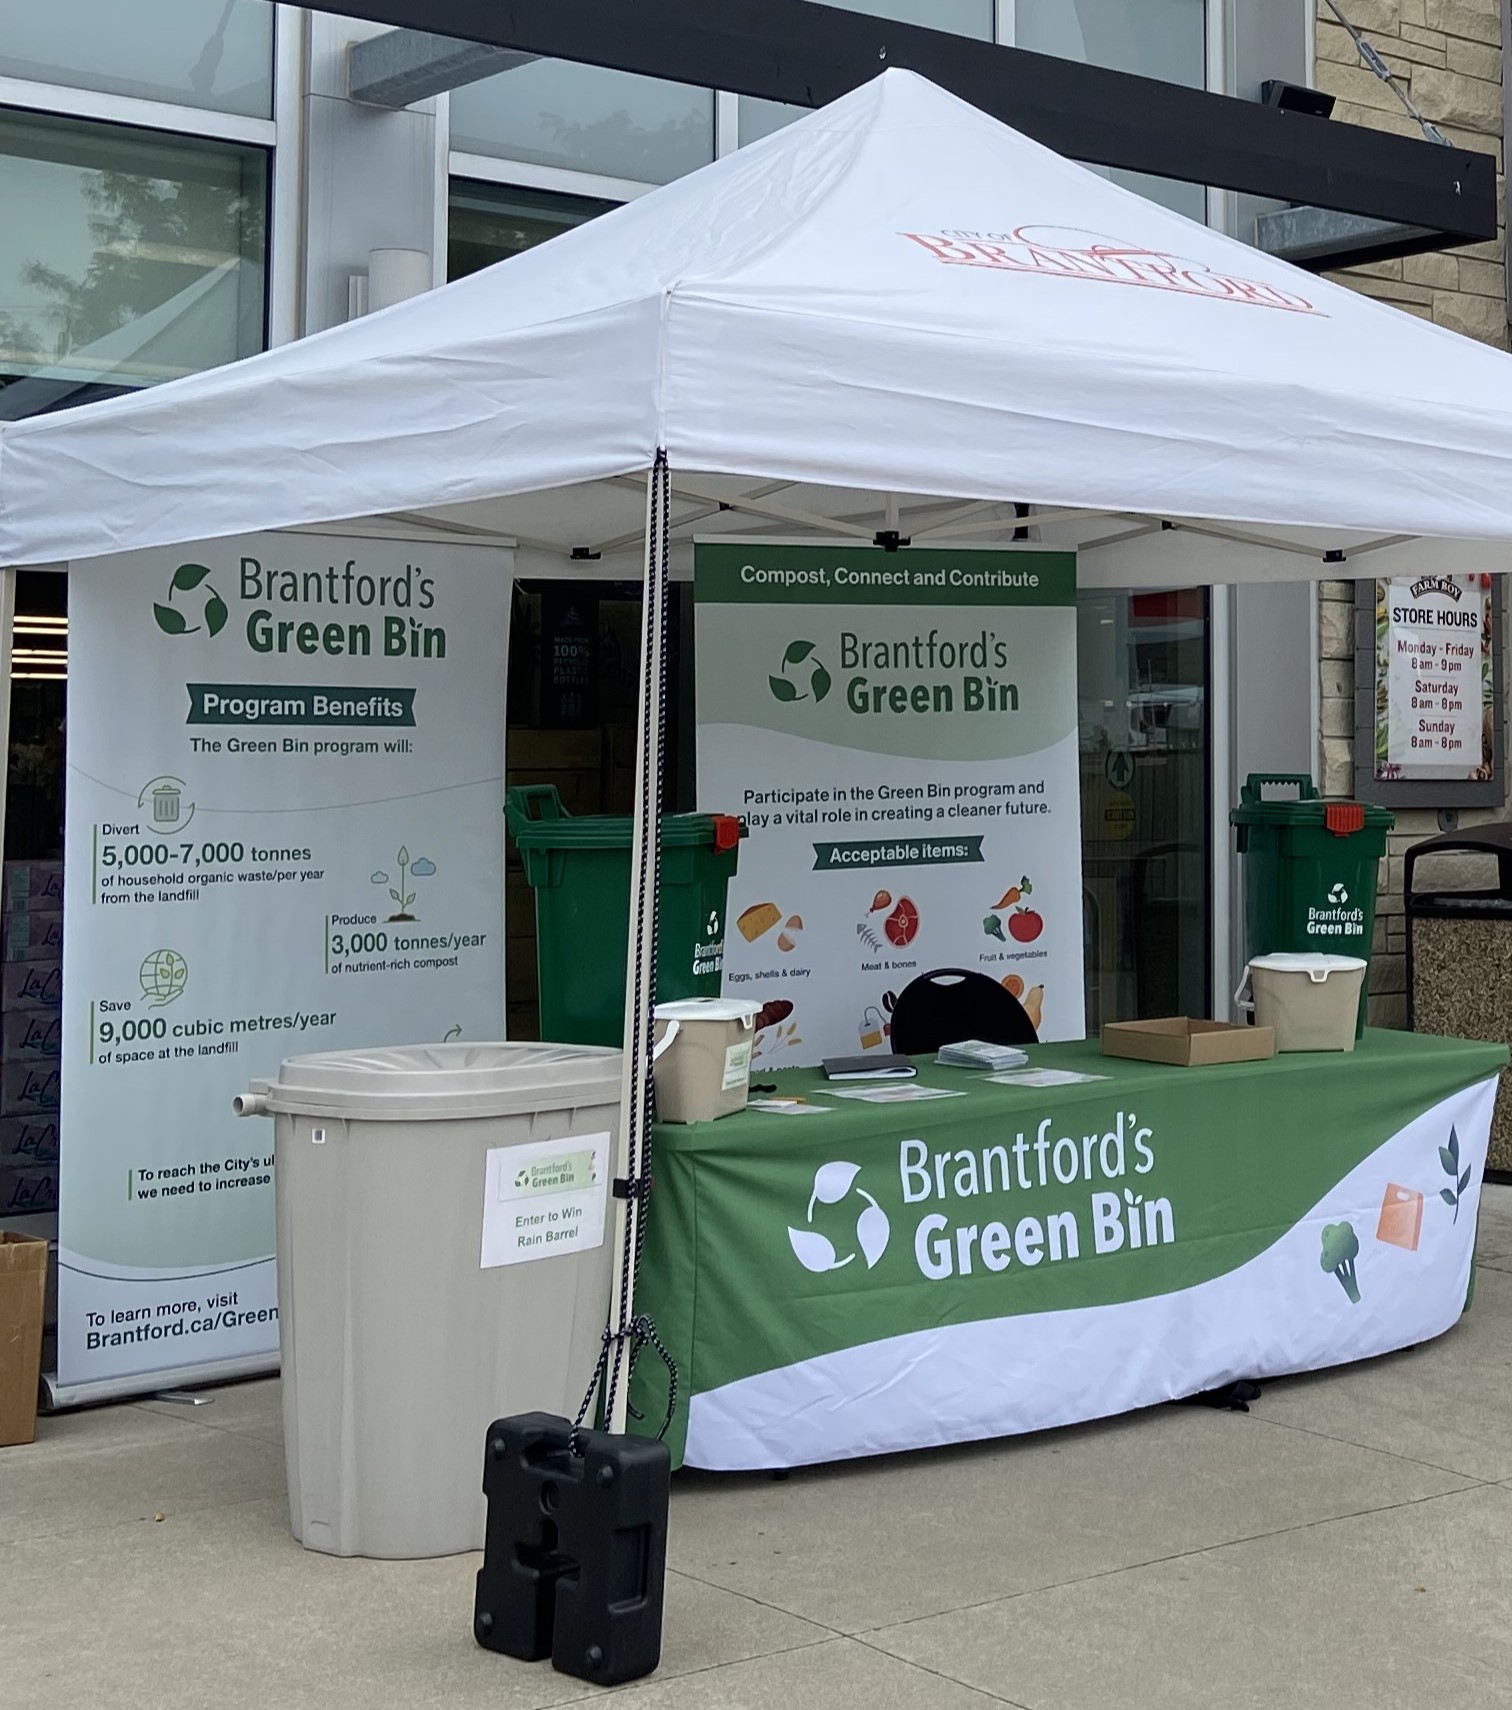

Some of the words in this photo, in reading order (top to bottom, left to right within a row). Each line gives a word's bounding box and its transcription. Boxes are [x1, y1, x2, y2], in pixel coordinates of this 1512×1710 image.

[941, 228, 982, 240] CITY
[988, 232, 1015, 242] OF
[897, 232, 1313, 310] BRANTFORD
[240, 557, 435, 609] Brantford's
[740, 565, 831, 588] Compost,
[834, 566, 910, 586] Connect
[913, 569, 946, 586] and
[949, 569, 1039, 587] Contribute
[1411, 579, 1439, 595] FARM
[1441, 579, 1461, 598] BOY
[1393, 607, 1433, 624] STORE
[1437, 610, 1477, 627] HOURS
[247, 609, 370, 656] Green
[384, 615, 446, 658] Bin
[553, 645, 590, 657] 100%
[841, 629, 1007, 669] Brantford's
[1397, 640, 1437, 657] Monday
[1445, 643, 1474, 658] Friday
[847, 676, 953, 714] Green
[963, 675, 1019, 712] Bin
[1415, 680, 1458, 697] Saturday
[203, 693, 305, 720] Program
[313, 695, 403, 717] Benefits
[1419, 719, 1455, 735] Sunday
[190, 737, 221, 752] The
[227, 737, 277, 753] Green
[282, 738, 309, 753] Bin
[314, 739, 378, 755] program
[384, 739, 413, 753] will:
[744, 788, 830, 806] Participate
[833, 786, 847, 801] in
[851, 786, 875, 801] the
[878, 785, 924, 800] Green
[927, 783, 951, 798] Bin
[954, 782, 1015, 799] program
[1018, 780, 1045, 795] and
[773, 813, 782, 824] a
[786, 809, 818, 824] vital
[822, 808, 851, 823] role
[855, 807, 868, 822] in
[871, 805, 933, 822] creating
[936, 808, 945, 819] a
[948, 803, 1001, 818] cleaner
[1005, 800, 1051, 815] future.
[102, 823, 139, 836] Divert
[102, 842, 244, 870] 5,000-7,000
[251, 846, 311, 862] tonnes
[830, 844, 919, 864] Acceptable
[922, 842, 968, 858] items:
[101, 873, 115, 887] of
[118, 871, 184, 887] household
[188, 870, 234, 886] organic
[238, 868, 296, 883] waste/per
[300, 868, 325, 882] year
[101, 891, 130, 904] from
[134, 890, 154, 903] the
[158, 888, 200, 902] landfill
[332, 914, 377, 925] Produce
[1308, 907, 1363, 921] Brantford's
[1307, 921, 1342, 935] Green
[1344, 922, 1363, 935] Bin
[332, 932, 388, 958] 3,000
[394, 932, 486, 951] tonnes/year
[331, 963, 342, 974] of
[345, 958, 410, 973] nutrient-rich
[414, 956, 459, 969] compost
[861, 961, 881, 971] Meat
[884, 961, 890, 969] &
[892, 960, 917, 969] bones
[979, 953, 996, 962] Fruit
[999, 952, 1005, 961] &
[1006, 950, 1047, 961] vegetables
[692, 959, 714, 975] Green
[728, 973, 752, 982] Eggs,
[755, 970, 779, 979] shells
[781, 968, 788, 977] &
[790, 967, 811, 977] dairy
[99, 1000, 131, 1012] Save
[99, 1018, 166, 1046] 9,000
[172, 1018, 224, 1037] cubic
[230, 1011, 337, 1033] metres/year
[99, 1051, 112, 1064] of
[115, 1051, 154, 1065] space
[158, 1047, 170, 1059] at
[174, 1046, 194, 1058] the
[198, 1041, 238, 1056] landfill
[900, 1111, 1154, 1204] Brantford's
[138, 1169, 154, 1181] To
[157, 1164, 195, 1179] reach
[200, 1162, 220, 1174] the
[225, 1157, 259, 1172] City's
[531, 1161, 572, 1176] Brantford's
[138, 1188, 157, 1199] we
[162, 1181, 194, 1196] need
[199, 1181, 211, 1192] to
[216, 1174, 271, 1190] increase
[532, 1177, 558, 1188] Green
[560, 1173, 574, 1184] Bin
[515, 1215, 545, 1228] Enter
[548, 1212, 558, 1222] to
[562, 1207, 582, 1219] Win
[518, 1235, 542, 1248] Rain
[546, 1226, 578, 1243] Barrel
[914, 1211, 1079, 1281] Green
[1091, 1187, 1175, 1255] Bin
[86, 1312, 105, 1327] To
[111, 1307, 151, 1324] learn
[157, 1300, 201, 1317] more,
[207, 1291, 238, 1309] visit
[87, 1307, 279, 1349] Brantford.ca/Green
